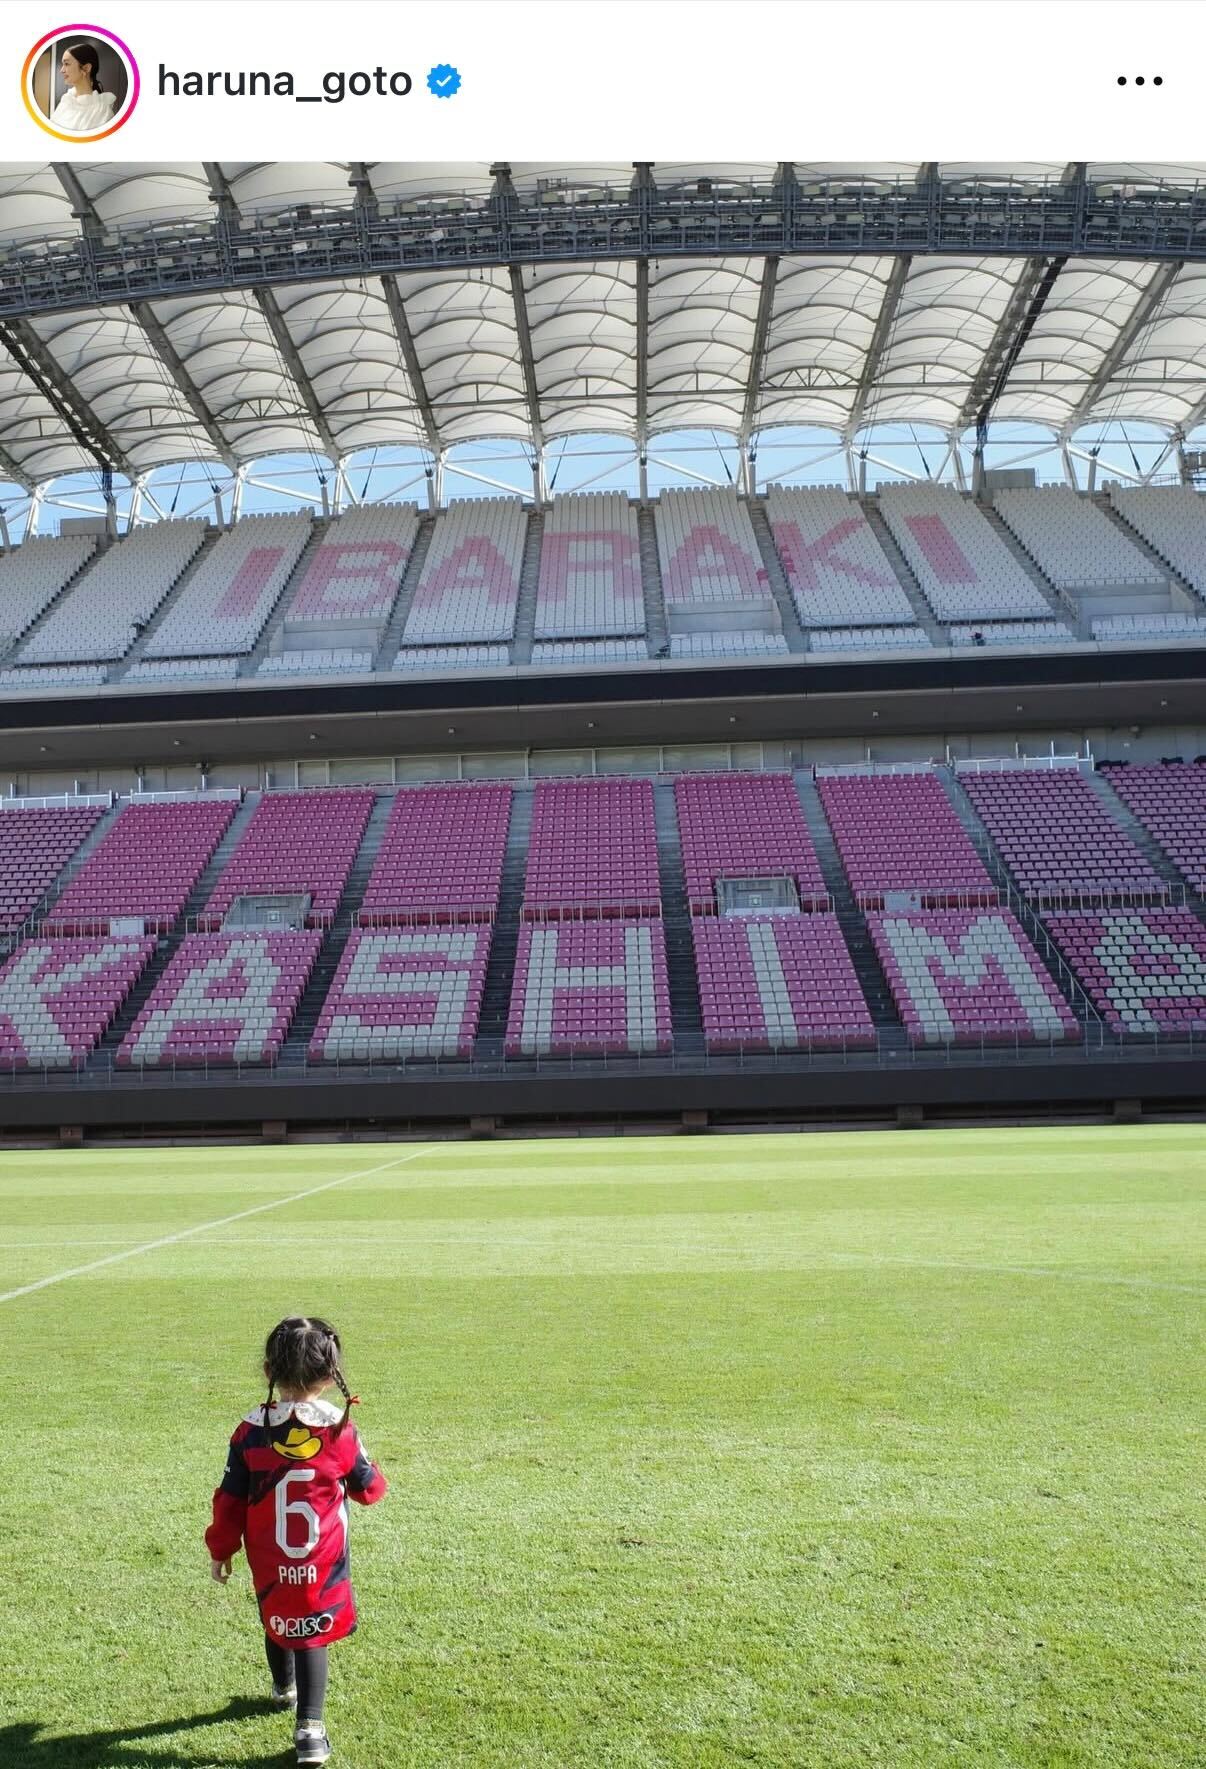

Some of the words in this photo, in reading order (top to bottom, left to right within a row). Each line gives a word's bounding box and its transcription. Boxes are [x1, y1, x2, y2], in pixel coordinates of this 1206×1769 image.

[214, 514, 977, 618] IBARAKI
[275, 1468, 320, 1558] 6
[278, 1564, 317, 1585] PAPA
[285, 1613, 334, 1637] RISO
